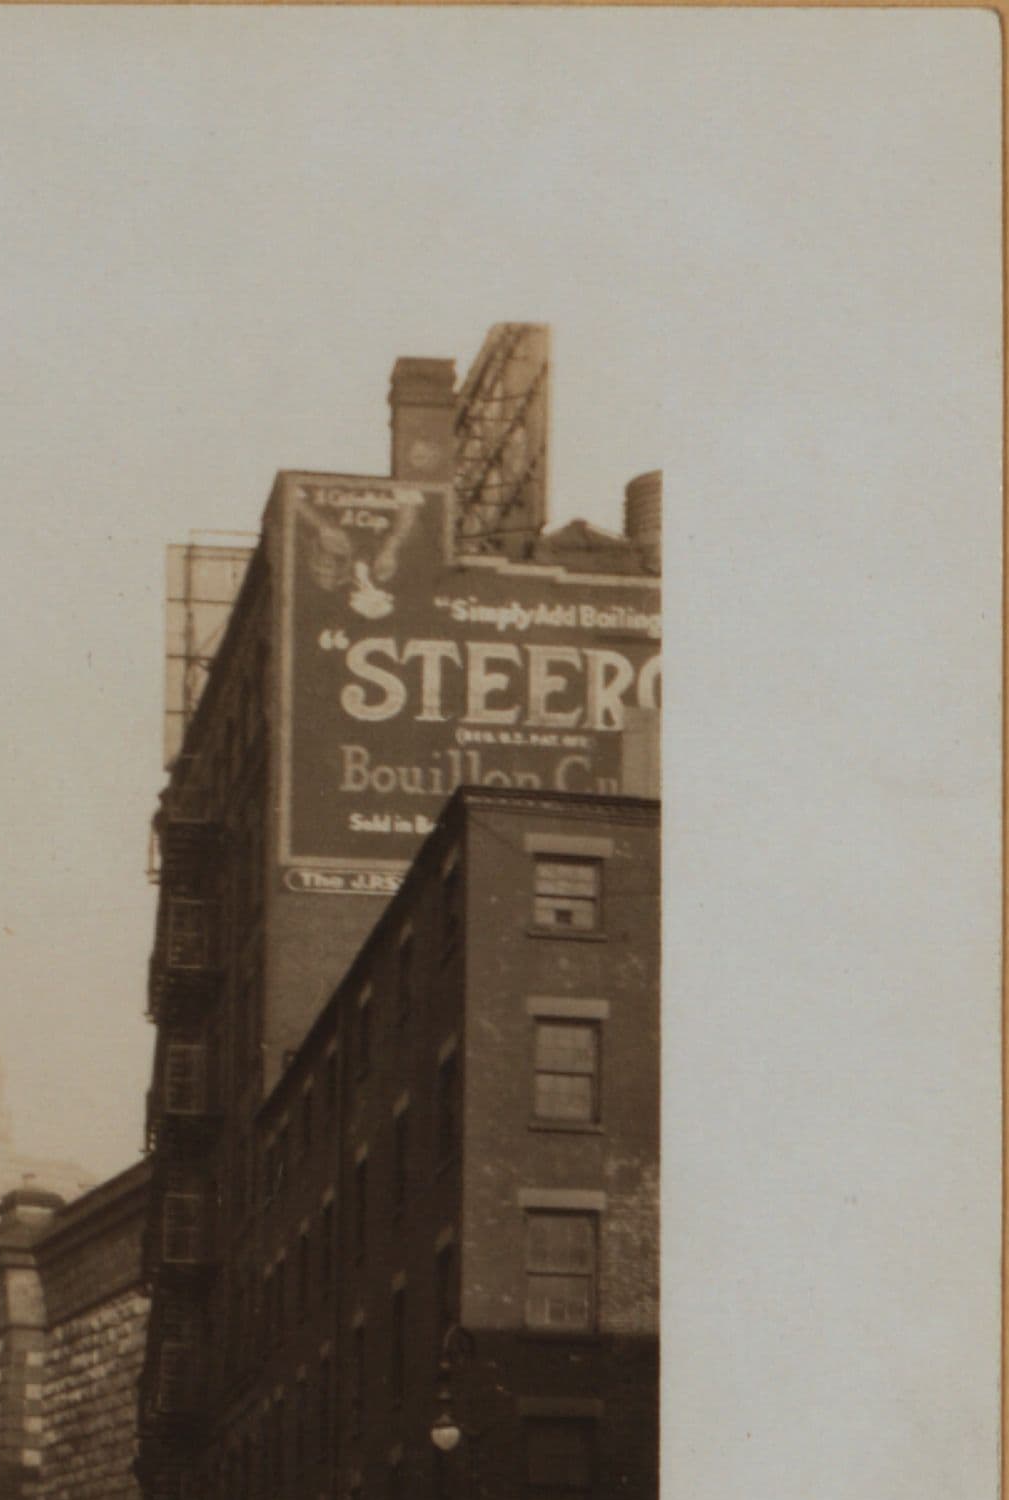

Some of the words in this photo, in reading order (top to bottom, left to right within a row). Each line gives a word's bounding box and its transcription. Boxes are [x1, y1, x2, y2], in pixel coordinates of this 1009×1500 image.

[535, 602, 576, 627] Add
[339, 745, 542, 796] Bouillon
[349, 813, 392, 833] Sold
[394, 814, 413, 833] in
[300, 872, 345, 889] The
